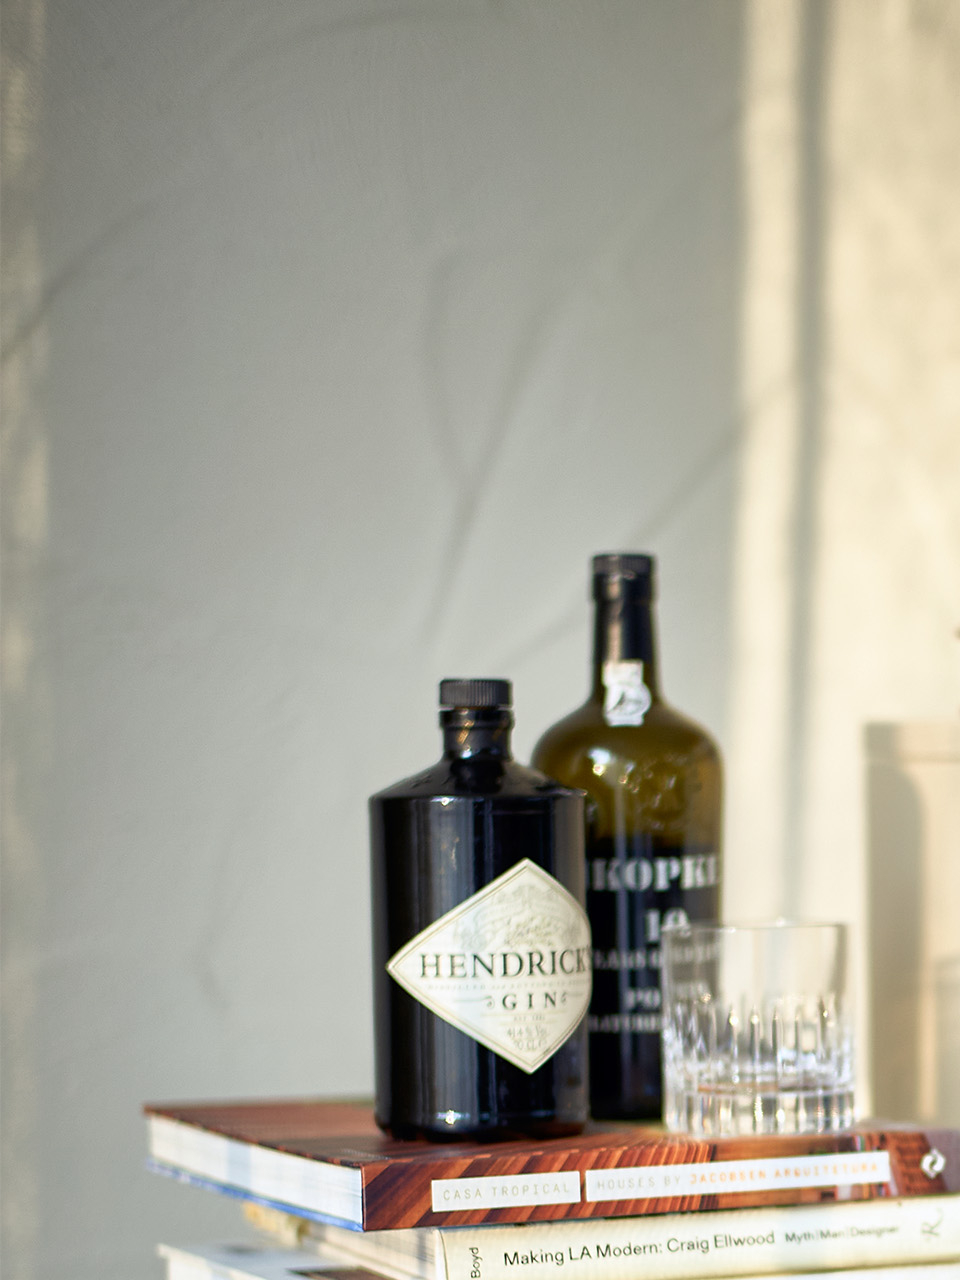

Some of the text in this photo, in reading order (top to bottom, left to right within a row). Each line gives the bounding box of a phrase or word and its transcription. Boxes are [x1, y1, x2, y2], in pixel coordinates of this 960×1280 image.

[502, 991, 558, 1011] GIN
[597, 1176, 656, 1191] HOUSES
[664, 1175, 681, 1188] BY
[690, 1170, 767, 1187] JACOBSEN
[443, 1182, 571, 1202] CASA TROPICAL
[503, 1247, 565, 1267] Making
[569, 1246, 592, 1261] LA
[596, 1242, 663, 1259] Modern:
[667, 1237, 710, 1254] Craig
[714, 1230, 776, 1249] Ellwood
[470, 1247, 483, 1279] Boyd
